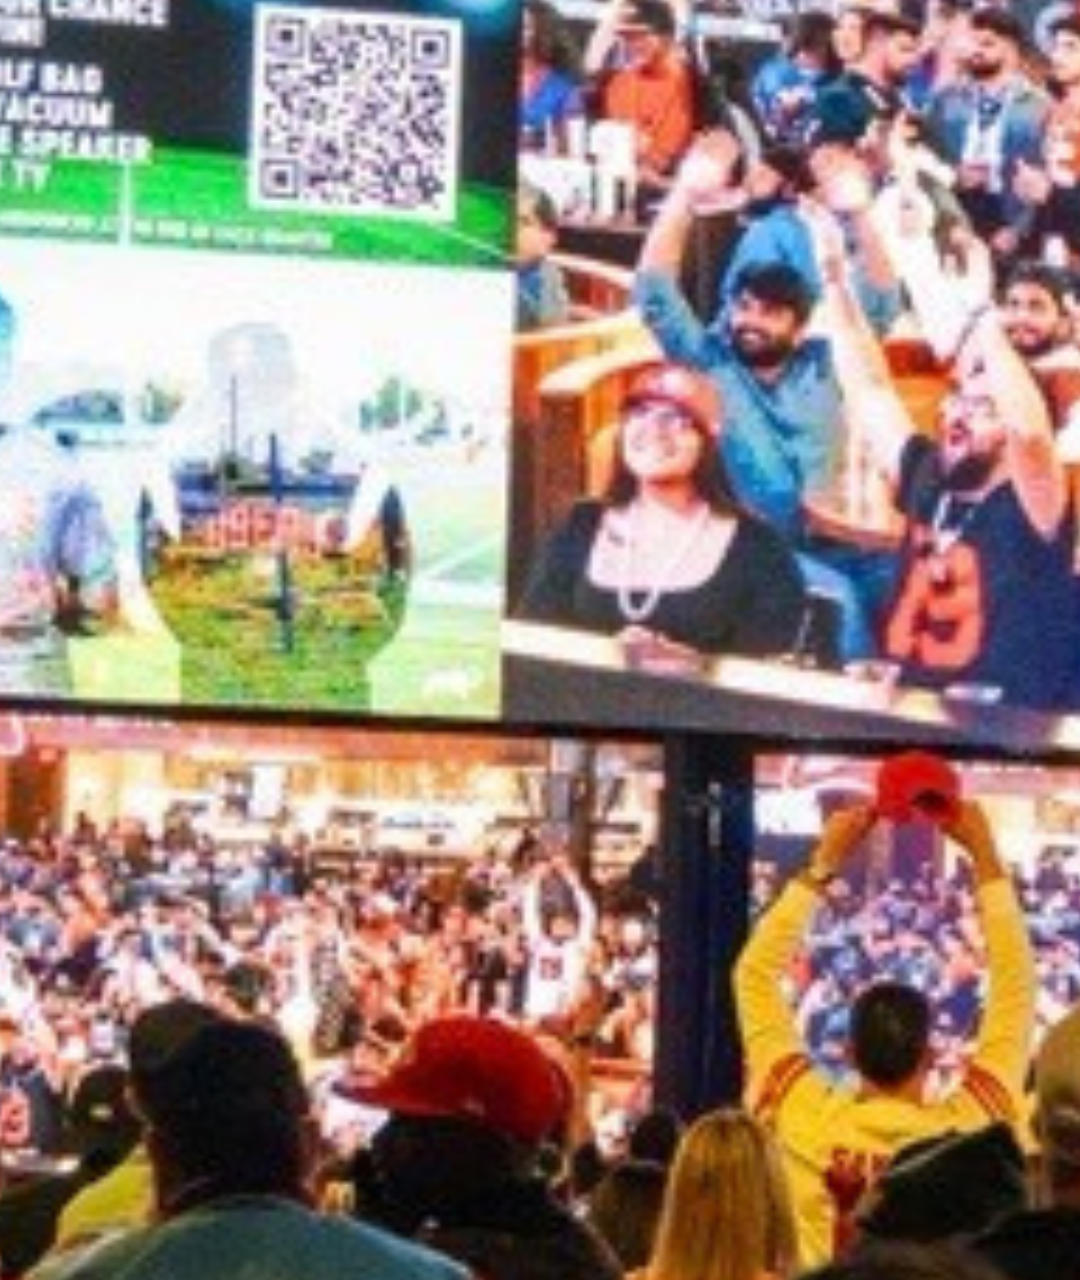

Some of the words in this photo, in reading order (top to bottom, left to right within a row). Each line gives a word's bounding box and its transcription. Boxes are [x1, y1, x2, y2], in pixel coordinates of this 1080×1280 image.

[0, 57, 35, 88] LF
[41, 62, 102, 94] BAG
[21, 127, 153, 166] SPEAKER
